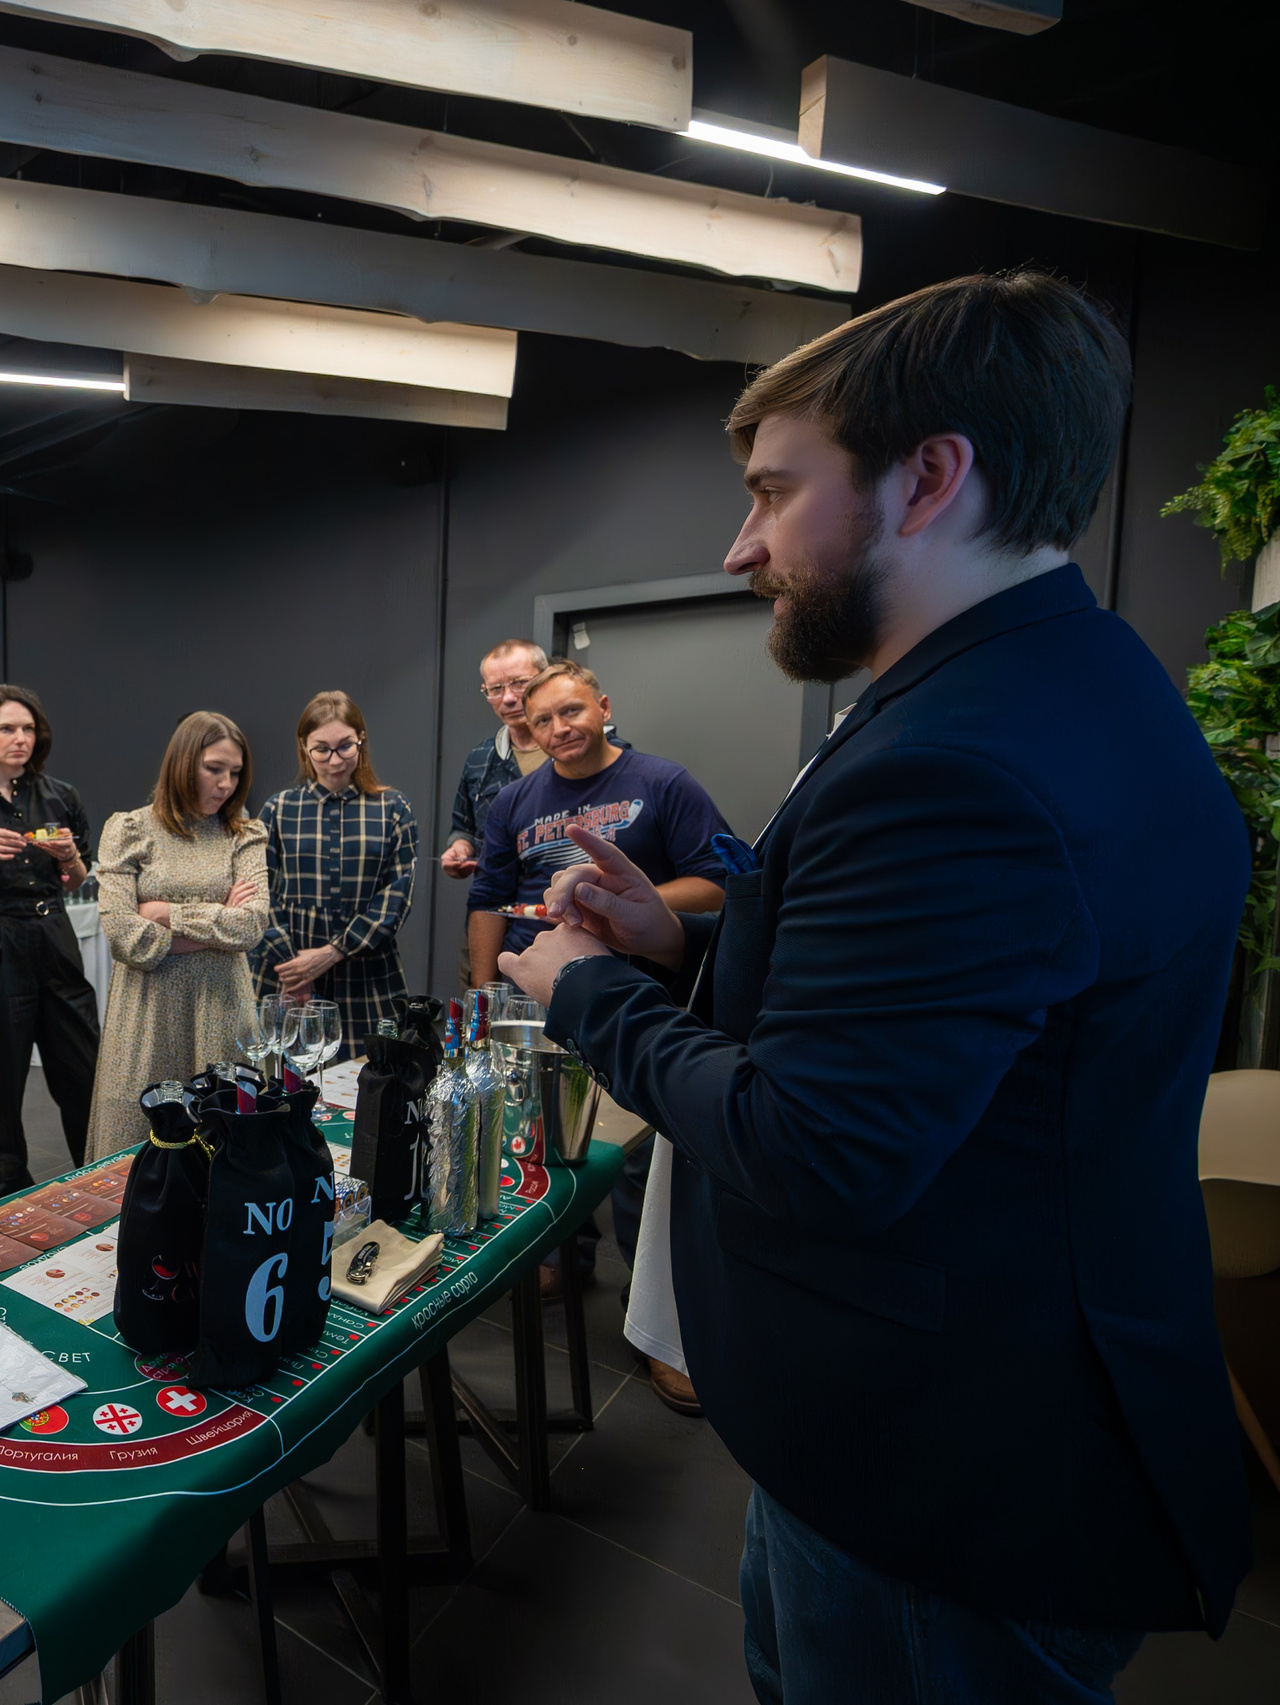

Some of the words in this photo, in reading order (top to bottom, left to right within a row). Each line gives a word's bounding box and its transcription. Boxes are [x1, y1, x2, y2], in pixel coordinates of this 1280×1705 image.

[534, 809, 569, 826] MADE
[577, 803, 591, 815] IN
[534, 800, 630, 845] PETERSBURG
[244, 1252, 289, 1342] 6
[411, 1290, 453, 1331] красные
[450, 1271, 479, 1299] сорта
[185, 1410, 253, 1446] Швейцария
[109, 1445, 159, 1462] Грузия
